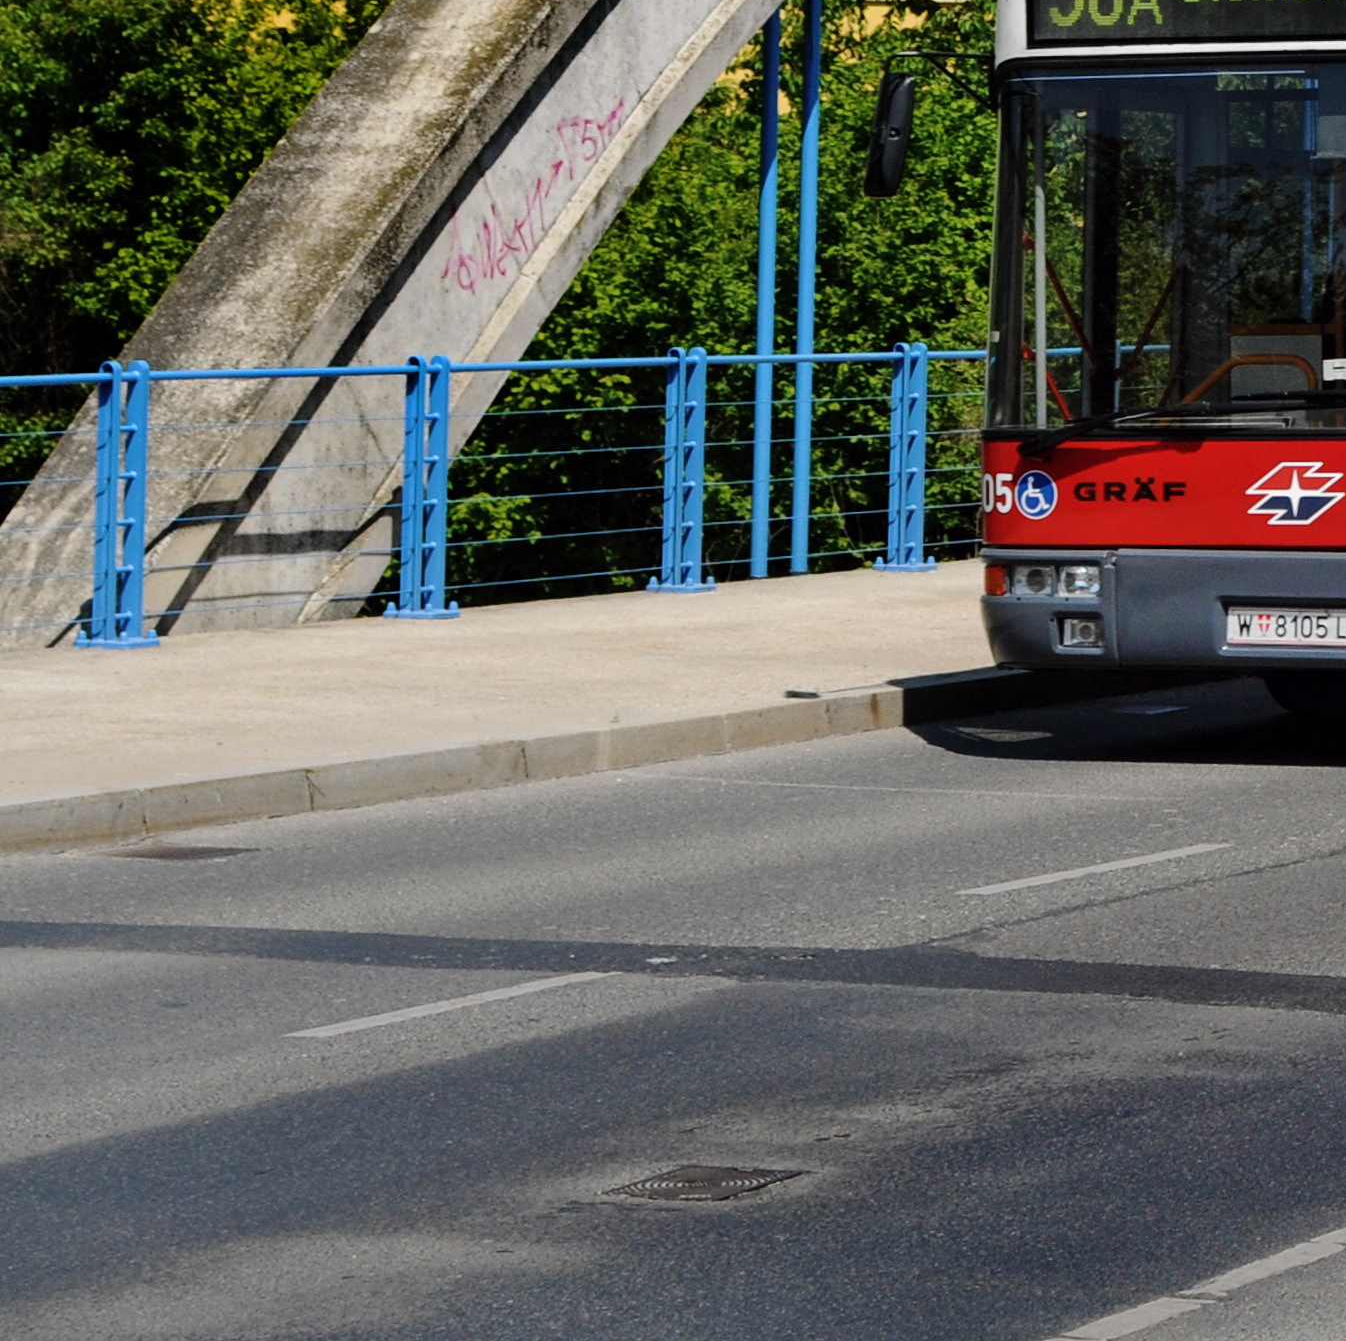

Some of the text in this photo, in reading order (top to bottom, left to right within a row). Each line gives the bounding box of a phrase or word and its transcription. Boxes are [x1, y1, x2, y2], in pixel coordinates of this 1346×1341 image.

[1073, 477, 1187, 502] GRÄF
[1237, 614, 1253, 637] W
[1275, 614, 1329, 639] 8105
